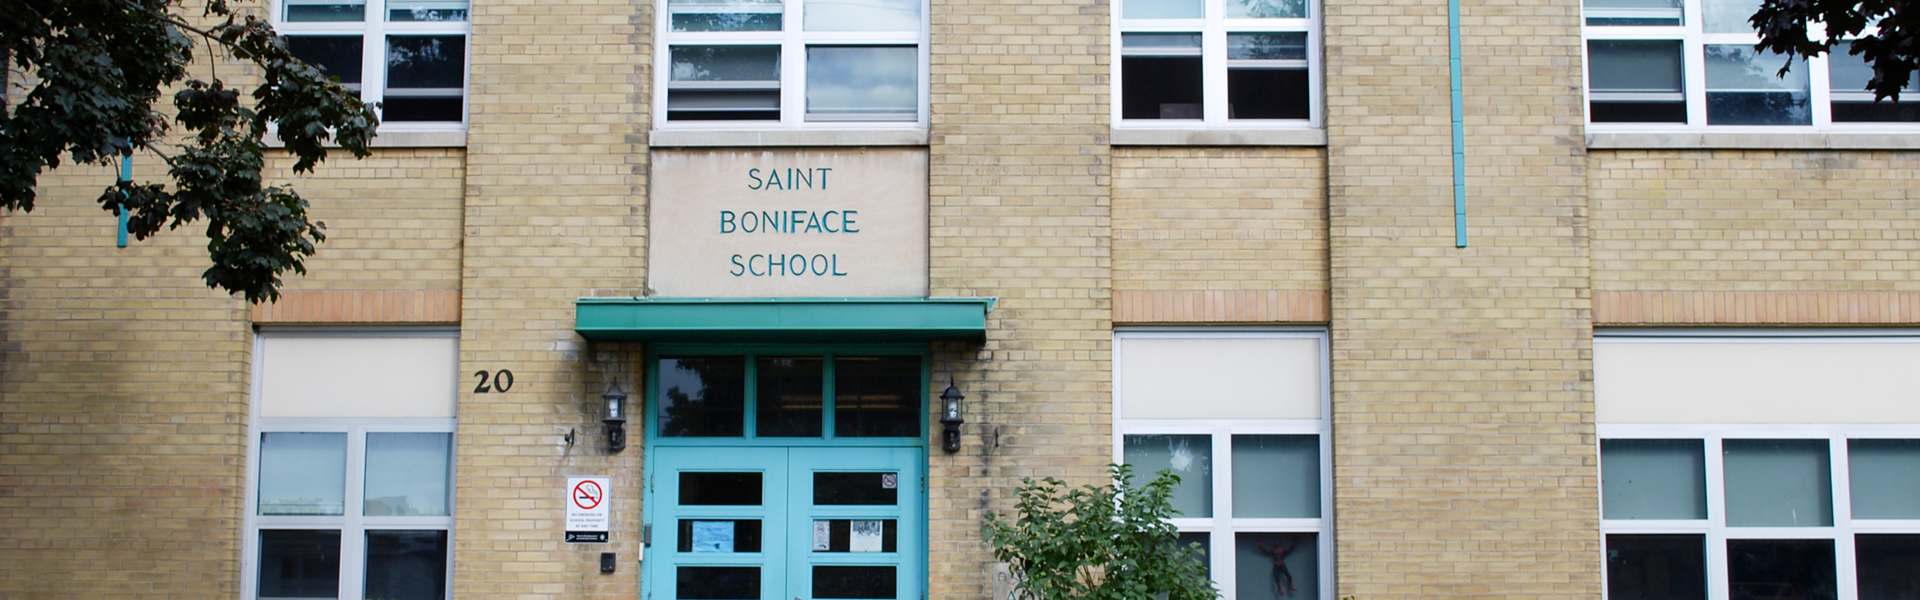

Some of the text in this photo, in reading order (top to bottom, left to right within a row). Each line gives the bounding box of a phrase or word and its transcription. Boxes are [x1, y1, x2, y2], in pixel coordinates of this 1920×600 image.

[748, 168, 833, 190] SAINT
[720, 210, 860, 234] BONIFACE
[730, 253, 848, 277] SCHOOL
[473, 369, 514, 393] 20
